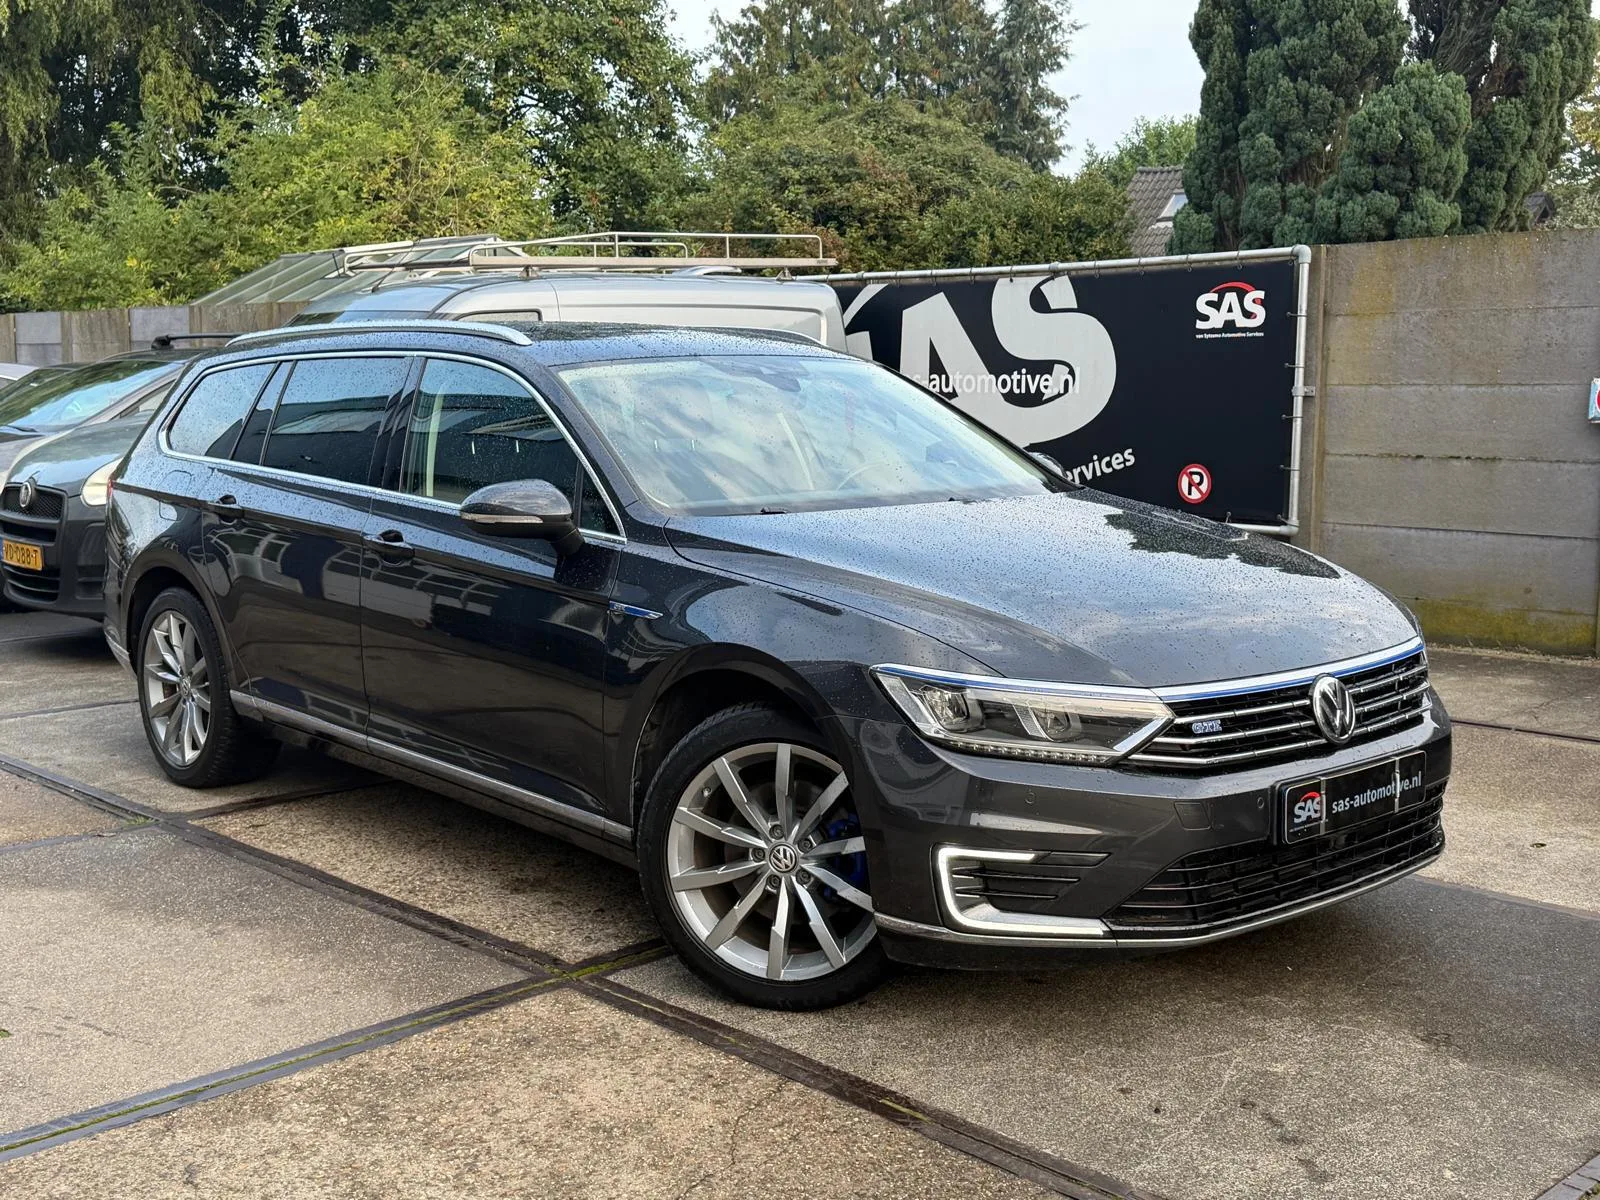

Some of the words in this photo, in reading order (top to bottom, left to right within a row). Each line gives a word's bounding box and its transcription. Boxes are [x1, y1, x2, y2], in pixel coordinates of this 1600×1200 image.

[1195, 290, 1266, 329] SAS
[905, 366, 1080, 395] s-automotive.nl
[1192, 720, 1222, 734] GTE
[1332, 770, 1422, 814] sas-automotve.nl
